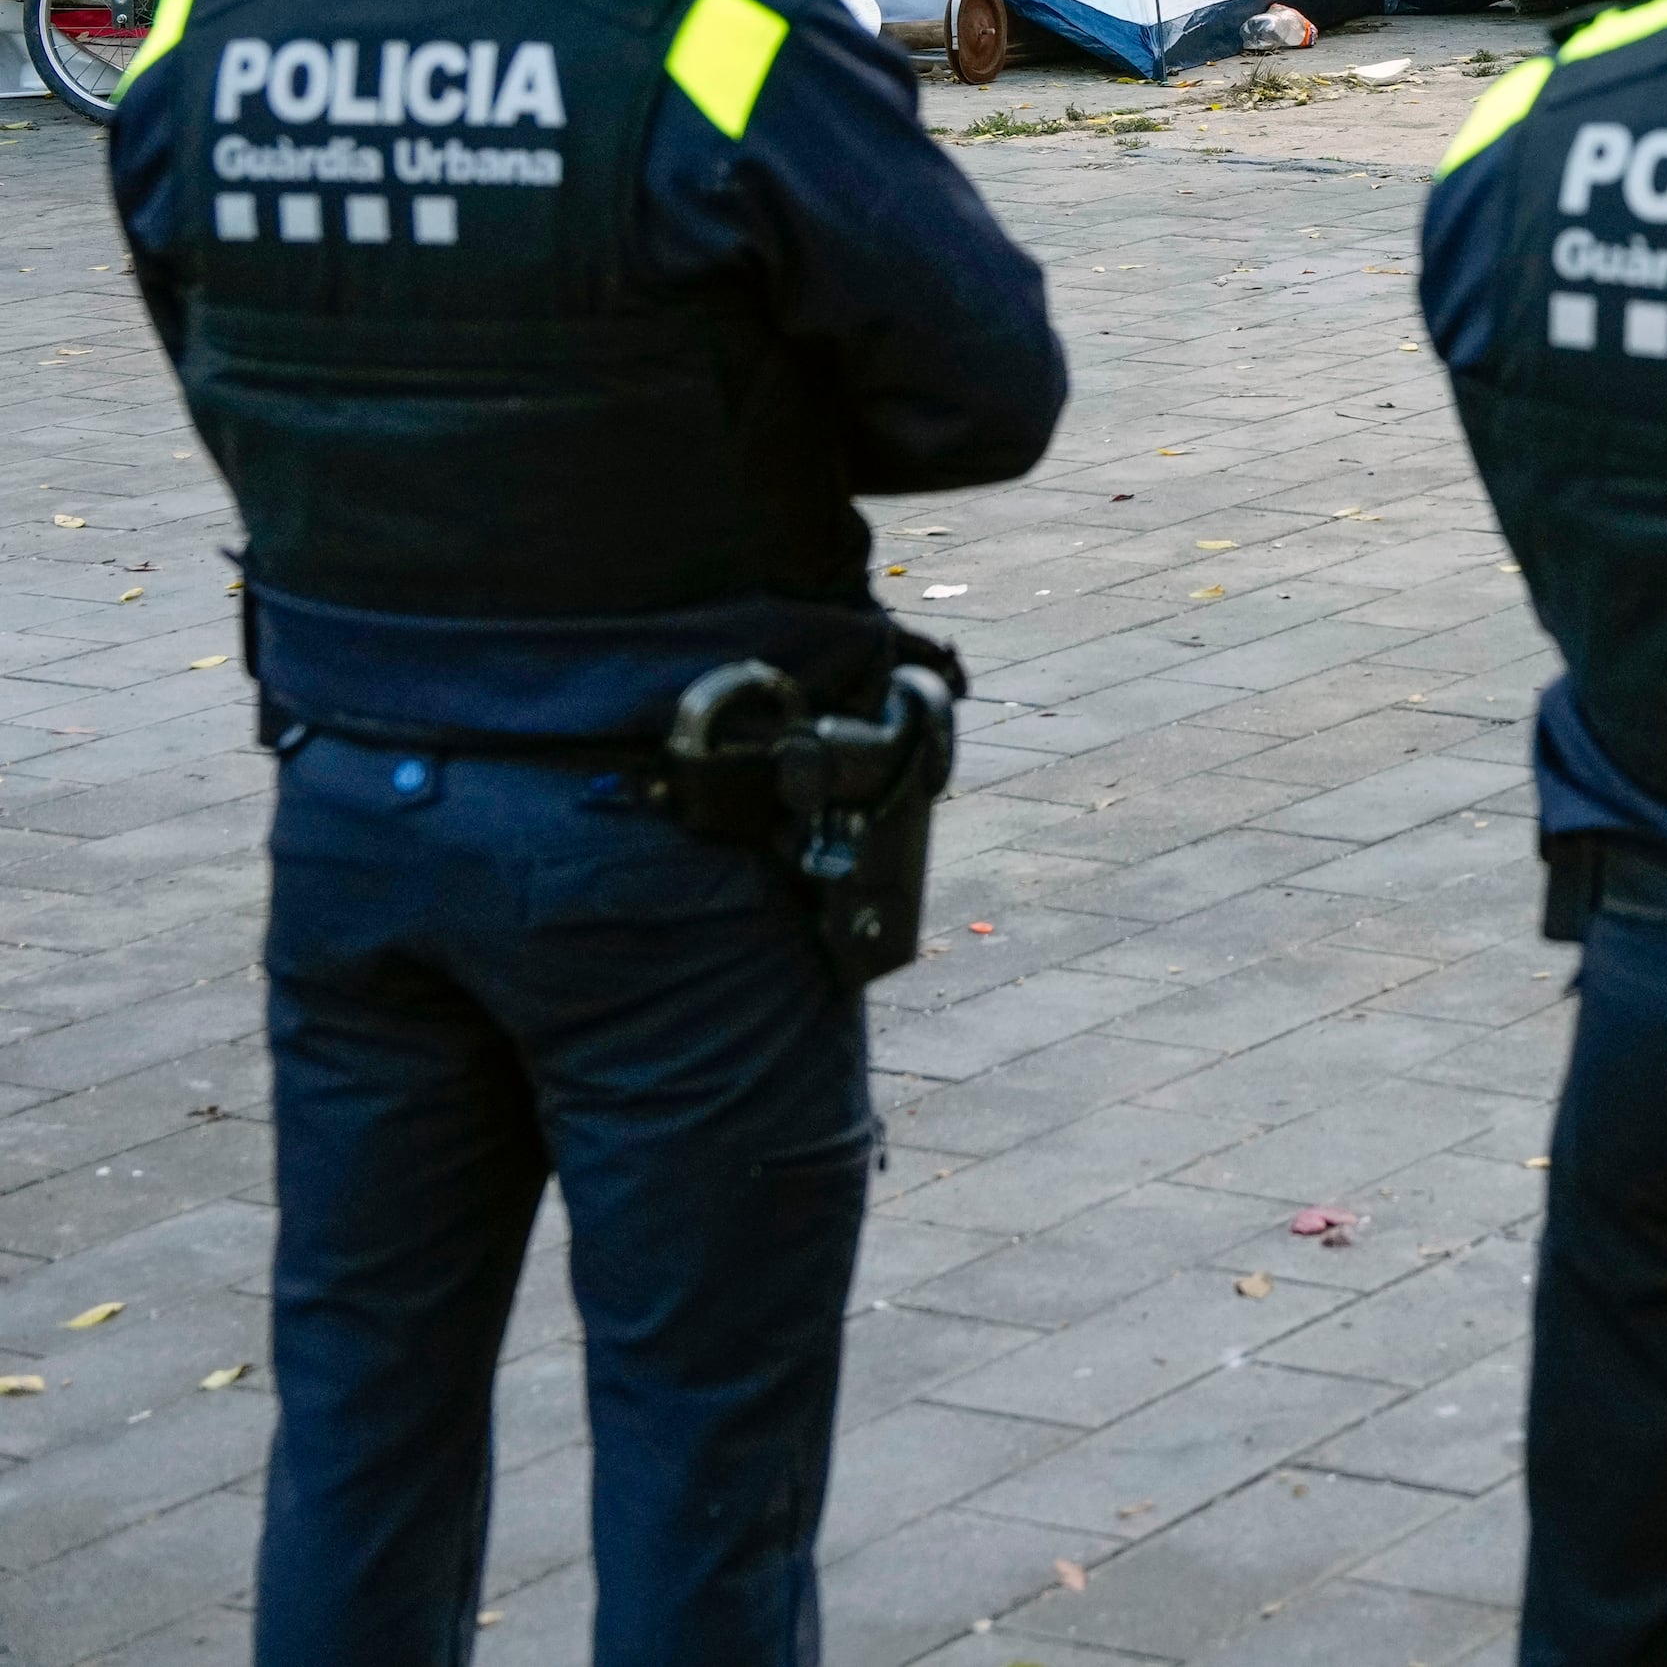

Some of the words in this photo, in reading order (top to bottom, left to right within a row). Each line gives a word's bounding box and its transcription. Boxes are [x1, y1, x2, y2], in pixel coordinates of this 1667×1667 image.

[214, 38, 566, 128] POLICIA
[213, 133, 384, 183] Guàrdia
[393, 137, 564, 187] Urbana
